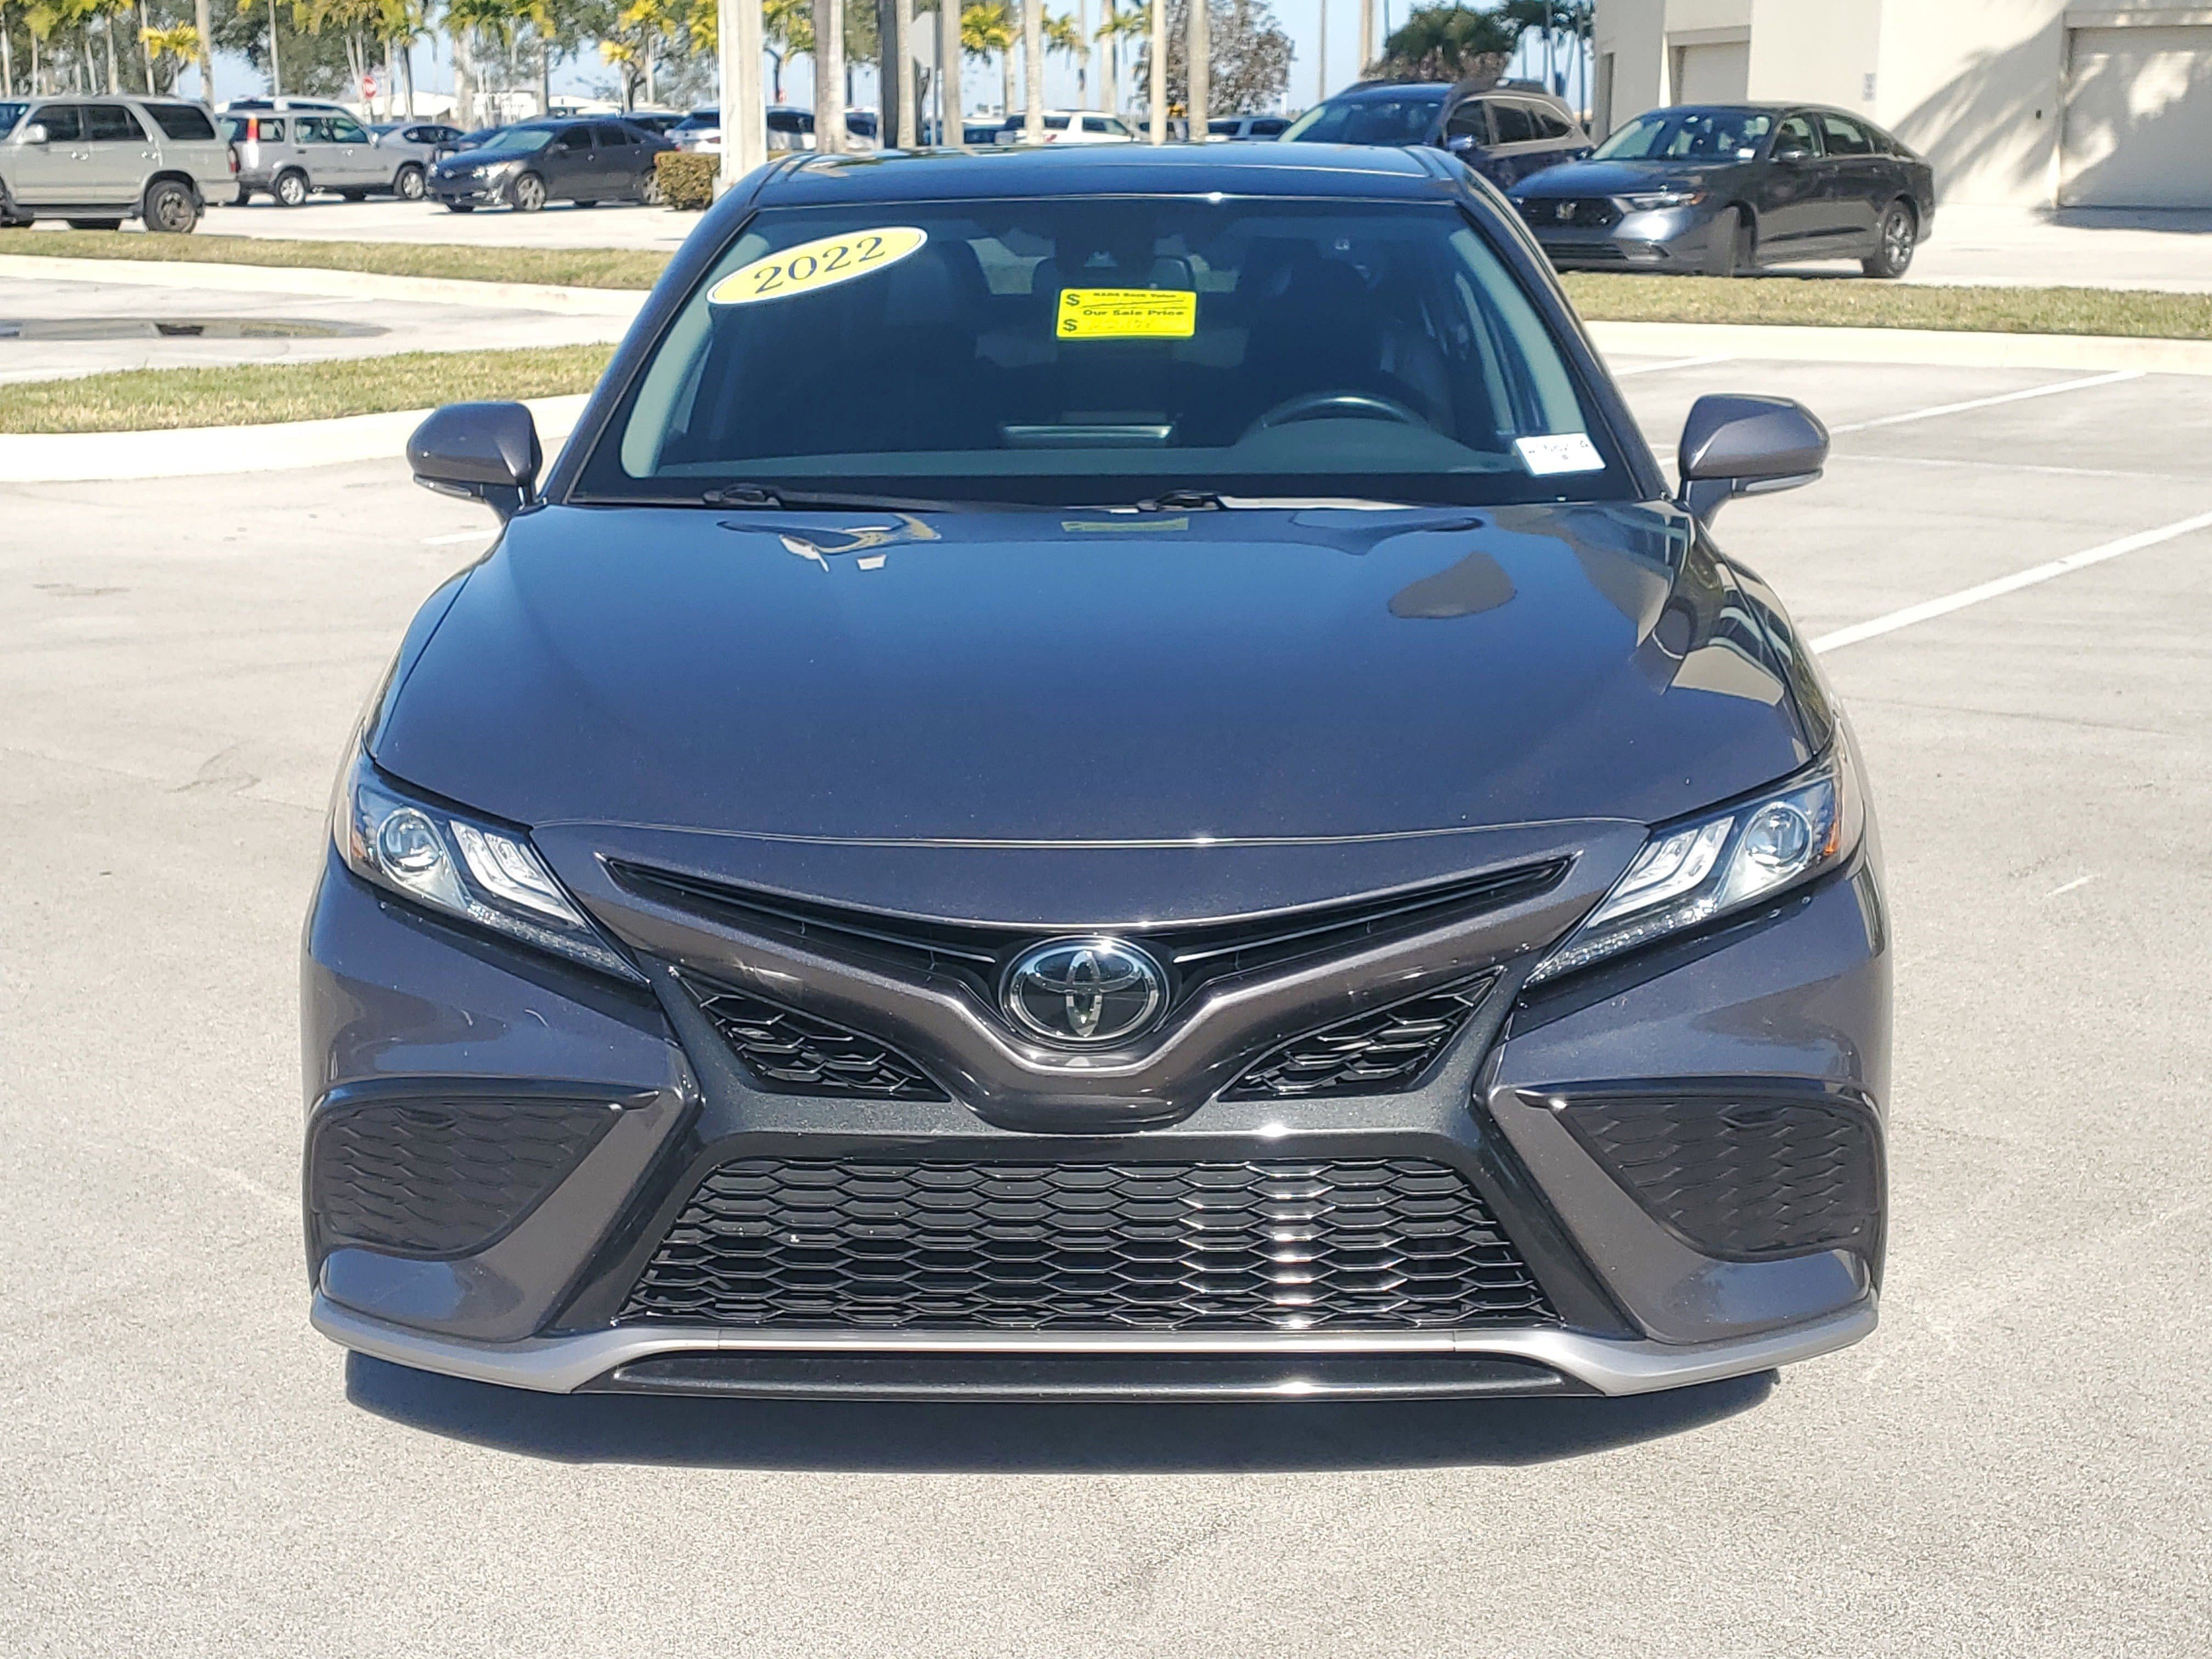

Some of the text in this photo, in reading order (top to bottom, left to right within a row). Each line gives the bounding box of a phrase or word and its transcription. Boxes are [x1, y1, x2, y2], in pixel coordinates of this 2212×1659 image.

[754, 236, 885, 294] 2022
[1065, 293, 1081, 307] $
[1062, 318, 1079, 332] $
